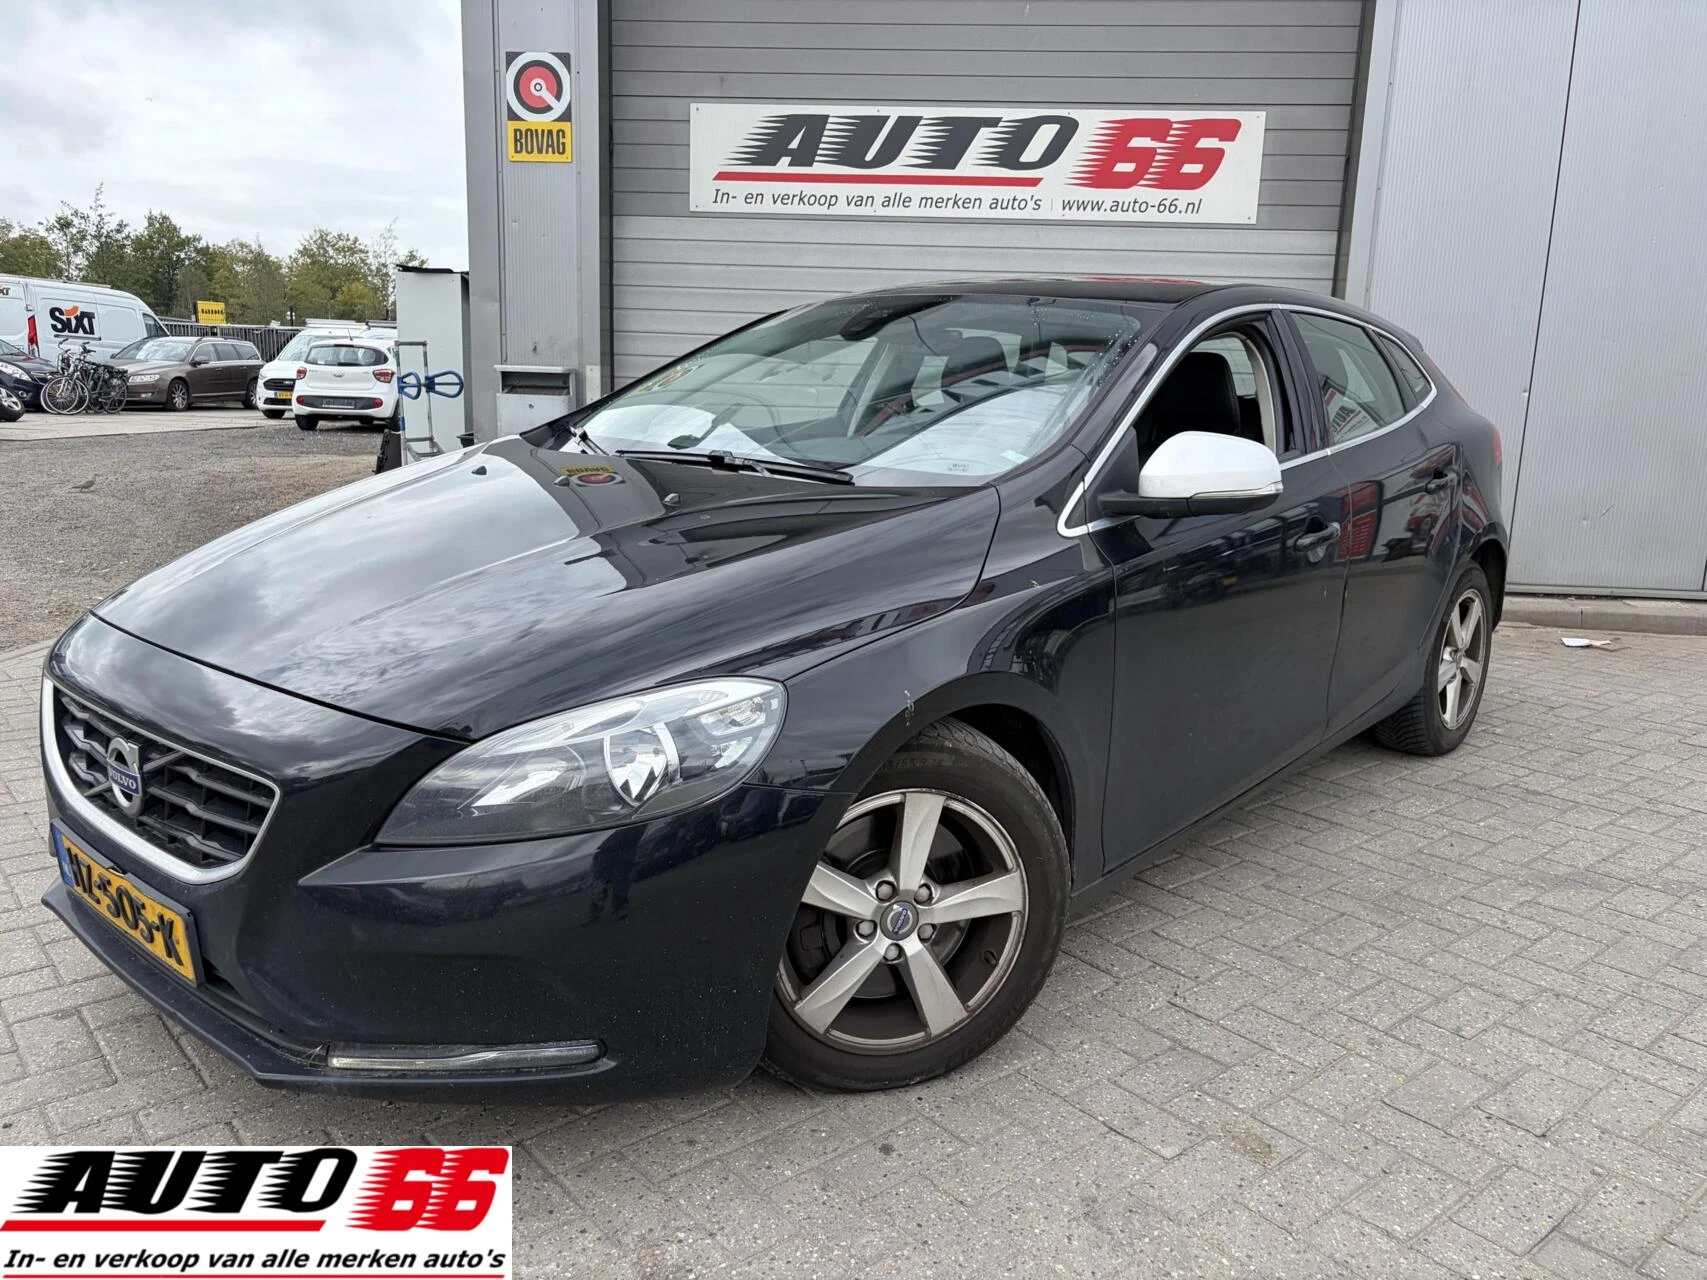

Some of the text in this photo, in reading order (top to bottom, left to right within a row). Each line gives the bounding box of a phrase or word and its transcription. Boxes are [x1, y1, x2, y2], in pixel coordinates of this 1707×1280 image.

[513, 128, 566, 155] BOVAG
[719, 114, 1242, 190] AUTO 66
[713, 189, 1042, 211] In- en verkoop van alle merken auto's
[1061, 198, 1202, 215] www.auto-66.nl
[66, 847, 184, 966] HZ-505-K
